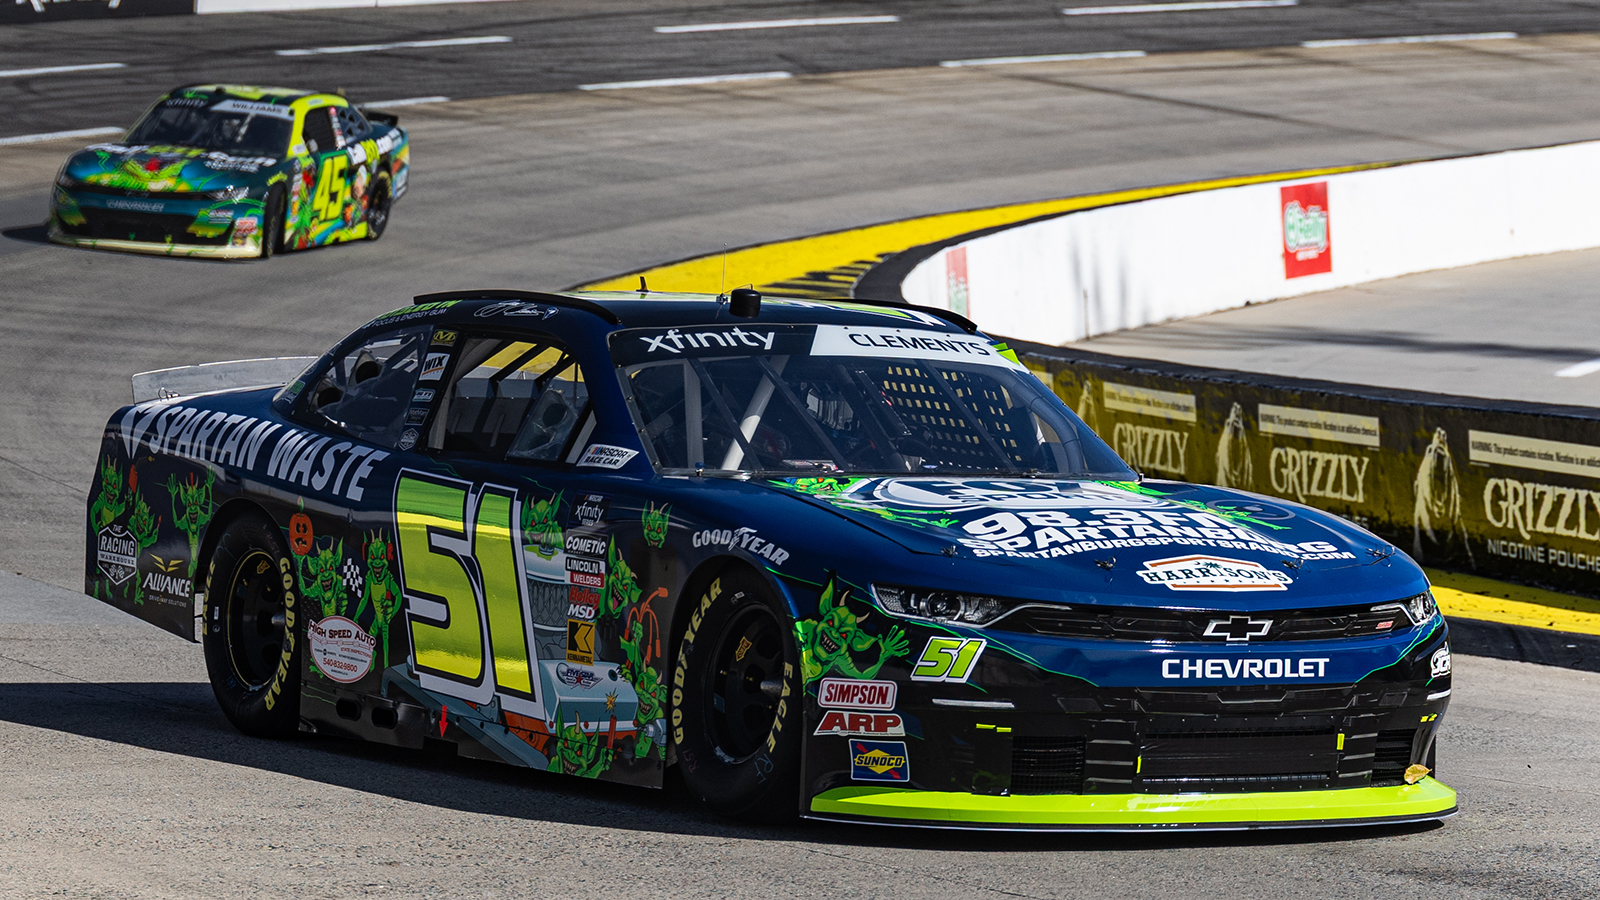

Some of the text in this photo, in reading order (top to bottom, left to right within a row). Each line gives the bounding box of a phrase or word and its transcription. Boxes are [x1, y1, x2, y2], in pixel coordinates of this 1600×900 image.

[232, 101, 283, 114] WILLIAMS
[312, 154, 349, 222] 45
[105, 199, 165, 213] CHEVROLET
[429, 308, 448, 317] GUM
[640, 326, 775, 353] xfinity
[848, 333, 990, 356] CLEMENTS
[424, 355, 446, 372] WIX
[150, 406, 391, 502] SPARTAN WASTE
[597, 447, 629, 459] NASCAR
[1114, 422, 1189, 475] GRIZZLY
[583, 456, 620, 465] RACE CAR
[1269, 447, 1370, 504] GRIZZLY
[574, 502, 604, 523] xfinity
[112, 524, 123, 533] THE
[100, 535, 135, 556] RACING
[566, 536, 606, 554] COMETIC
[1487, 538, 1546, 563] NICOTINE
[100, 553, 135, 566] WAREHOUSE
[566, 559, 599, 575] LINCOLN
[142, 572, 192, 598] ALLIANCE
[573, 573, 602, 587] WELDERS
[1141, 566, 1290, 584] HARRISON'S
[392, 466, 546, 722] 51
[569, 585, 601, 610] Holley
[567, 603, 596, 620] MSD
[309, 620, 376, 647] HIGH SPEED AUTO
[911, 636, 987, 683] 51
[1161, 657, 1330, 679] CHEVROLET
[825, 682, 890, 705] SIMPSON
[766, 661, 793, 753] EAGLE
[819, 712, 901, 733] ARP
[856, 755, 903, 768] SUNOCO
